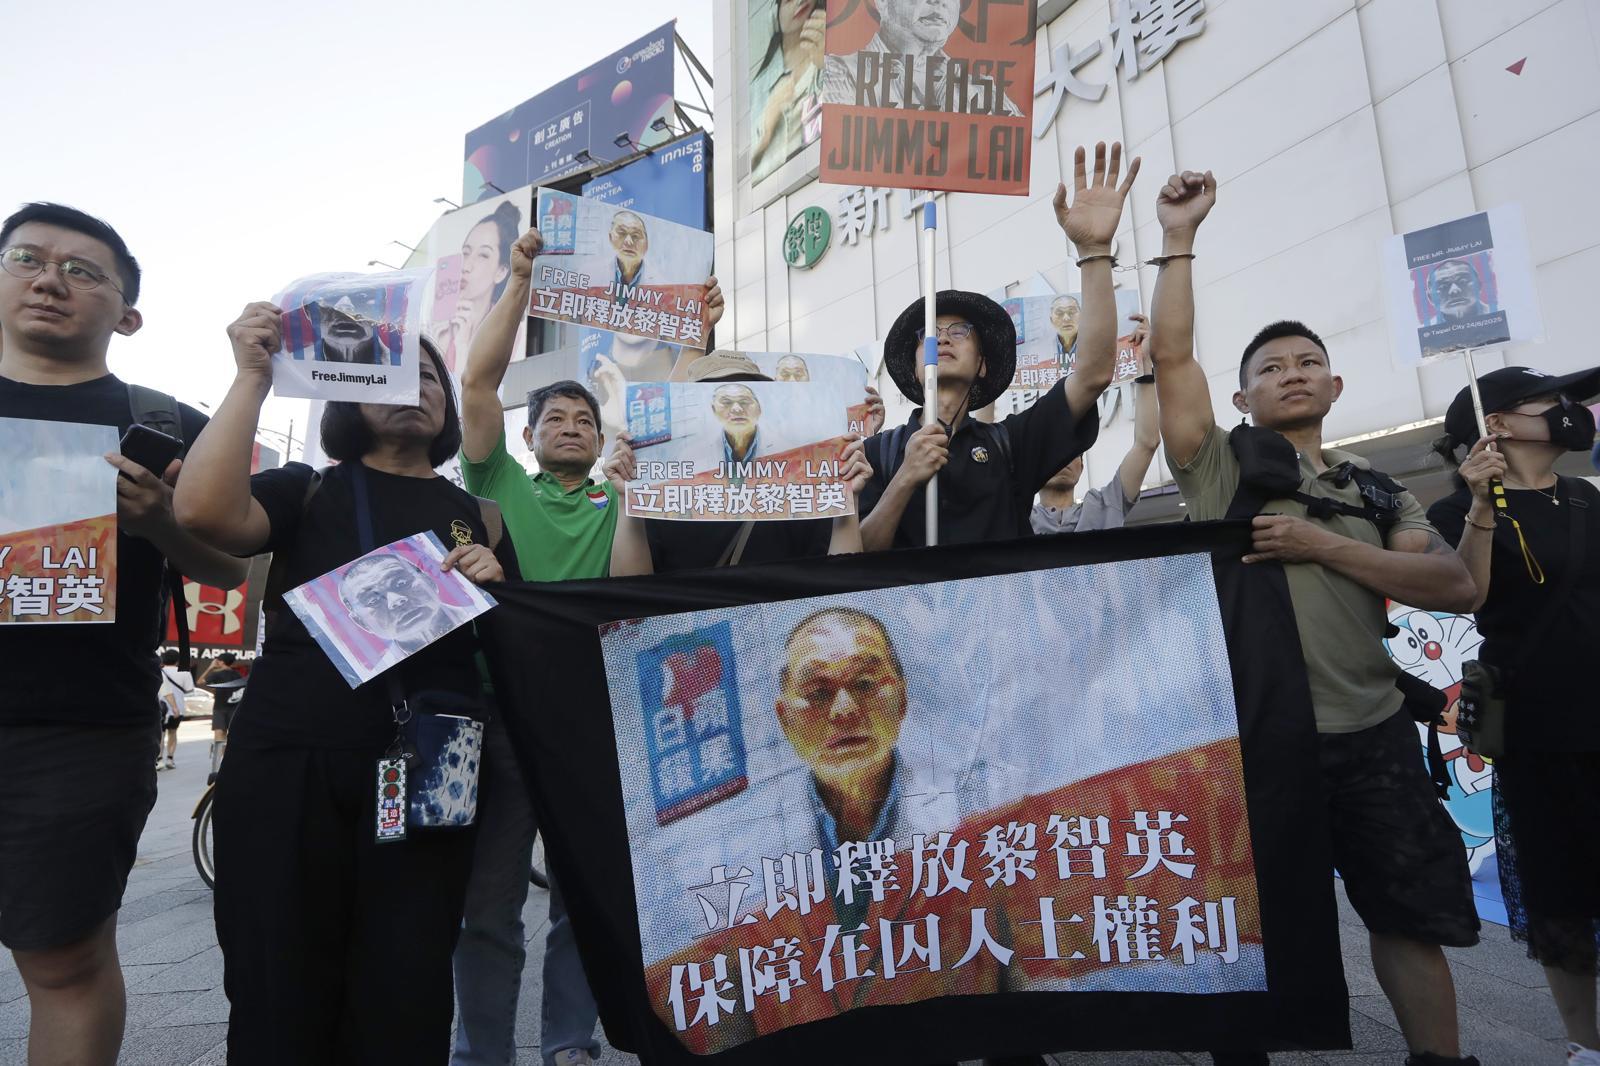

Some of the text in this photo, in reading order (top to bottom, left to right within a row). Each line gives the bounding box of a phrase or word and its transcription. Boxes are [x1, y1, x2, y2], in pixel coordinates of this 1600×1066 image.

[855, 51, 1017, 117] RELEASE
[534, 110, 584, 145] 創立廣告
[544, 131, 572, 150] CREATION
[828, 114, 949, 177] JIMMY
[967, 123, 1025, 182] LAI
[541, 265, 703, 315] FREE JIMMY LAI
[533, 286, 703, 344] 立即釋放黎智英
[311, 370, 387, 386] FreeJimmyLai
[1050, 353, 1077, 365] JIM
[636, 460, 840, 480] FREE JIMMY LAI
[631, 482, 847, 515] 立即釋放黎智英
[42, 545, 97, 570] LAI
[0, 574, 105, 617] 智英
[688, 811, 1197, 940] 立即釋放黎智英
[666, 896, 1240, 1032] 保障在囚人士權利
